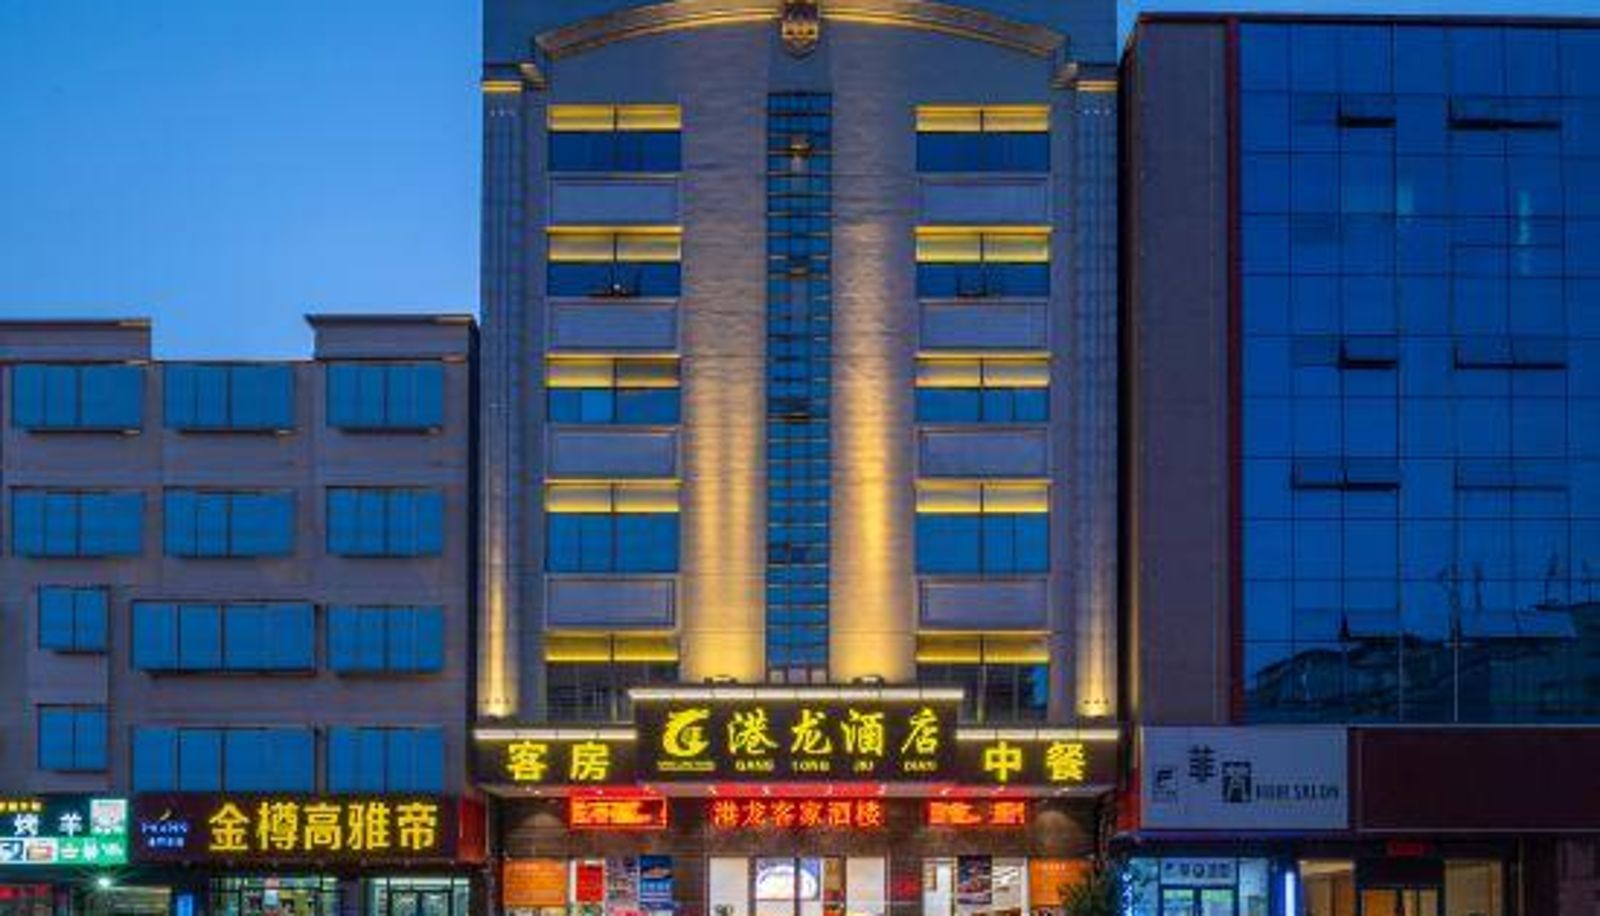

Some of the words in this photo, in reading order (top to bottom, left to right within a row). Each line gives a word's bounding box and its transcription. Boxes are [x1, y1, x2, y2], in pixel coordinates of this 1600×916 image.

[726, 707, 939, 757] 港龙酒店
[506, 741, 610, 781] 客房
[983, 741, 1086, 782] 中餐
[207, 801, 438, 851] 金樽高雅帝
